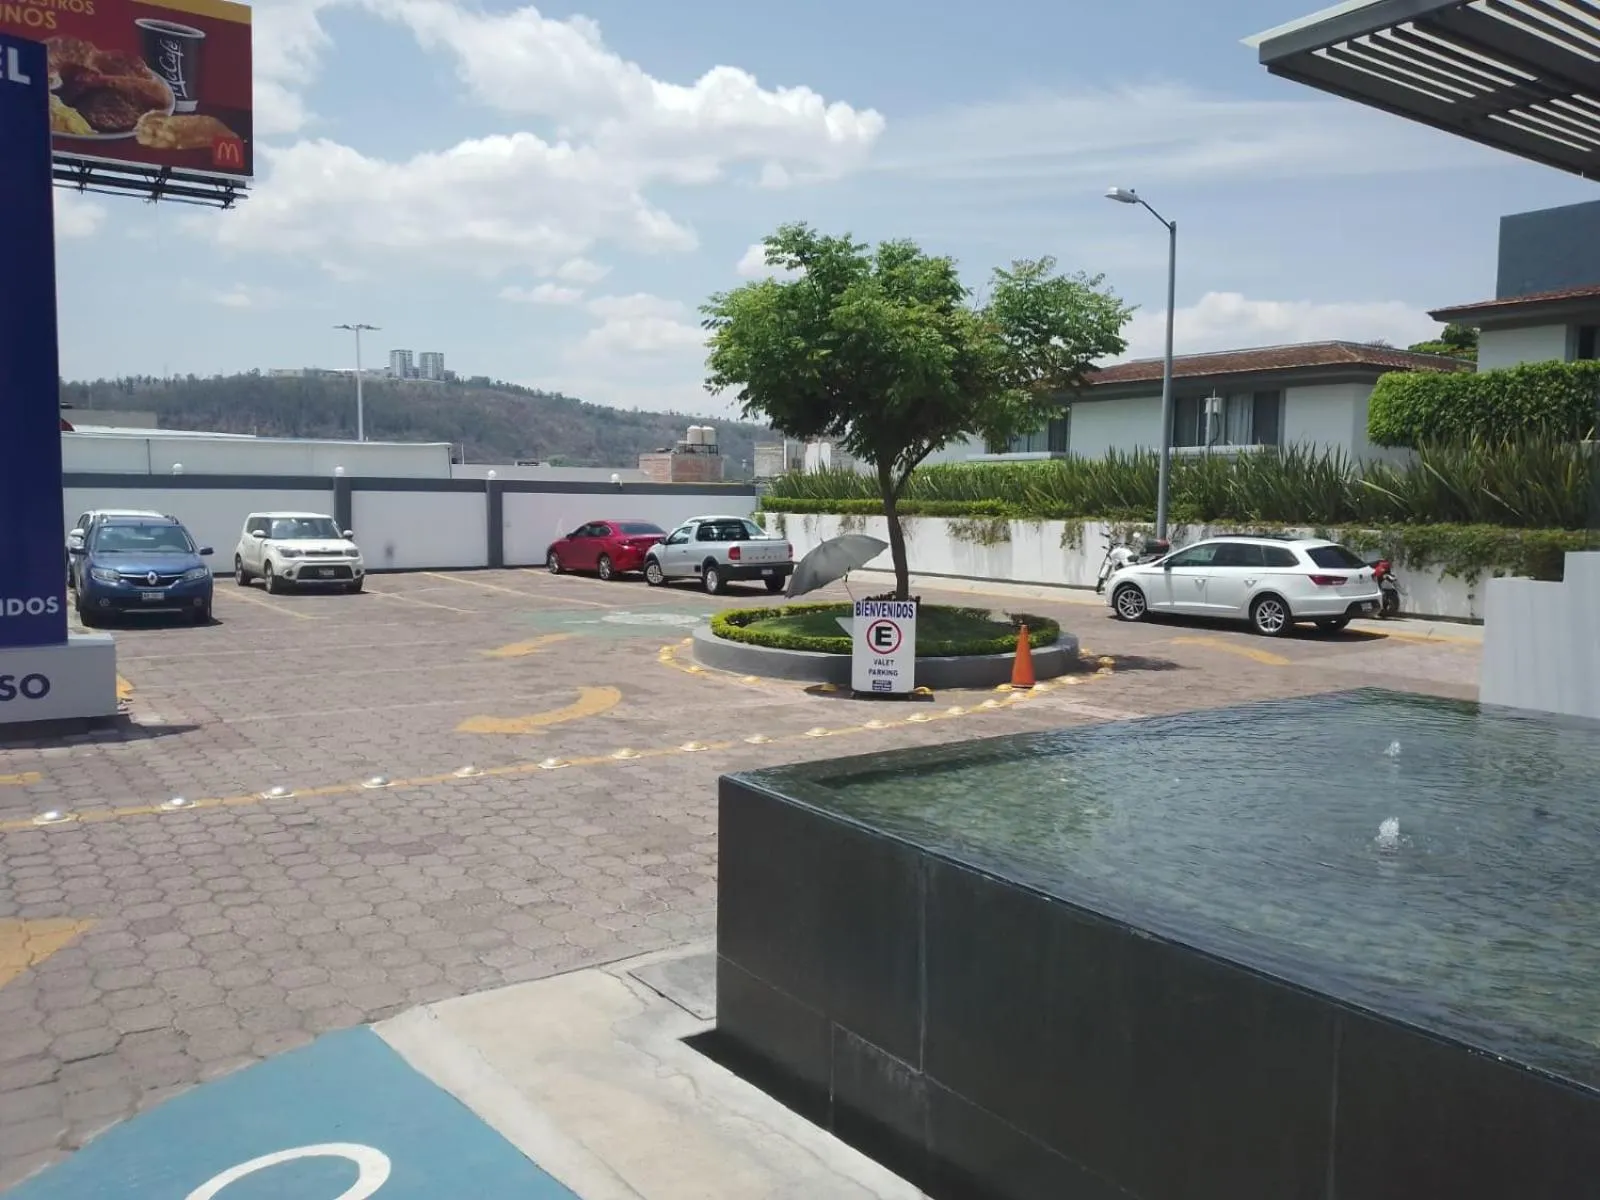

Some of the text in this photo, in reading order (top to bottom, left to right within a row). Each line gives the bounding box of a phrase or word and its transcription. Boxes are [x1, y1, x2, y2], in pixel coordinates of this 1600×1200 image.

[0, 4, 57, 29] NOS
[0, 45, 31, 85] L
[856, 602, 913, 618] BIENVENIDOS
[875, 626, 892, 646] E
[868, 668, 898, 676] PARKING
[873, 658, 894, 666] VALET
[0, 673, 51, 701] SO
